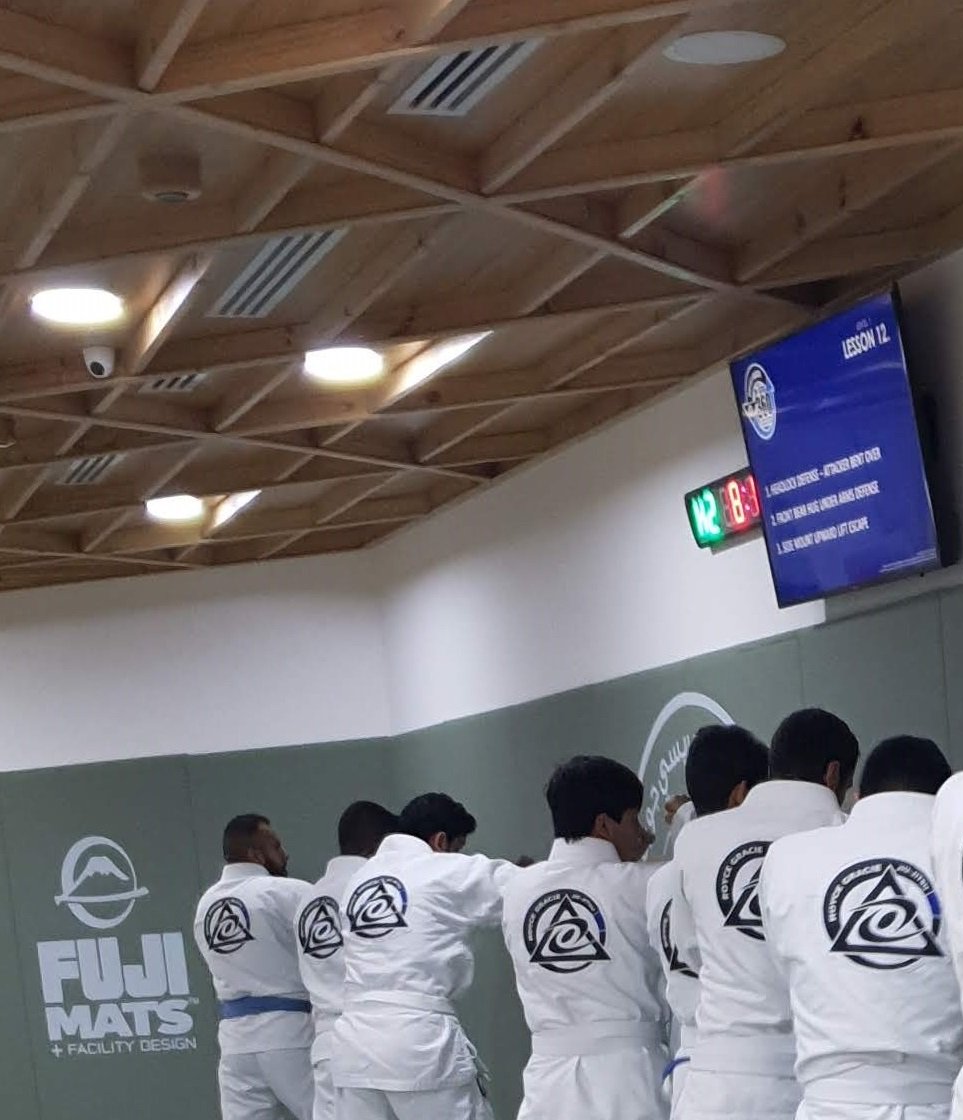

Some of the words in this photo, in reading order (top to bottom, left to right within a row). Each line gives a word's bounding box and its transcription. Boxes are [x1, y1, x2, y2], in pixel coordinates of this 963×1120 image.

[842, 328, 875, 359] LESSON
[796, 468, 820, 487] DEFENSE
[823, 458, 850, 478] ATTACKER
[864, 446, 882, 463] OVER
[776, 509, 793, 525] FRONT
[819, 494, 838, 511] UNDER
[838, 488, 855, 504] ARMS
[854, 480, 880, 499] DEFENSE
[793, 533, 814, 549] MOUNT
[837, 522, 849, 537] LIFT
[848, 516, 869, 533] ESCAPE
[37, 932, 190, 1003] FUJI
[45, 999, 194, 1041] MATS
[67, 1040, 135, 1056] FACILITY
[140, 1037, 197, 1053] DESIGN
